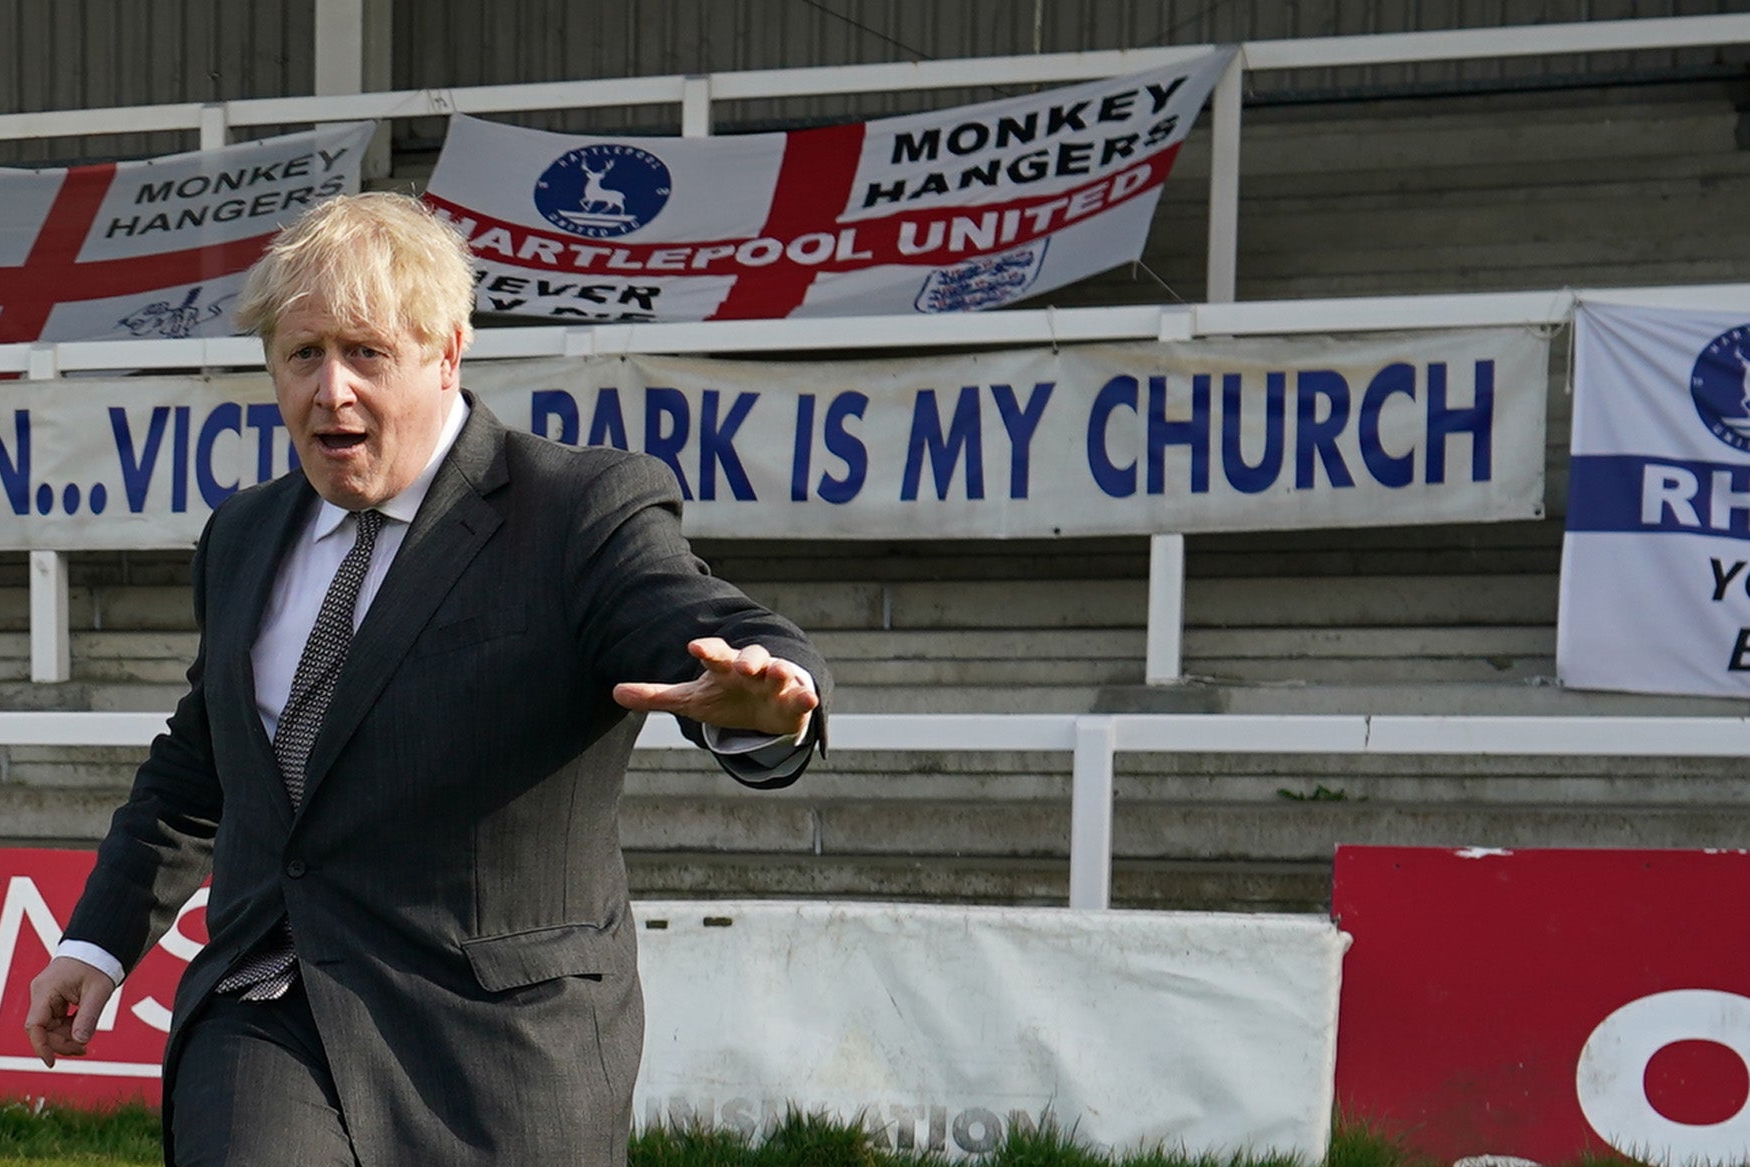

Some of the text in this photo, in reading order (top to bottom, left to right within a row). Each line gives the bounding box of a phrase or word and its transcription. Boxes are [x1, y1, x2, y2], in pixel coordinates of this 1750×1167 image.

[863, 115, 1178, 208] HANGERS
[891, 76, 1188, 164] MONKEY
[105, 175, 345, 238] HANGERS
[135, 149, 349, 204] MONKEY
[434, 163, 1152, 271] HARTLEPOOL UNITED
[791, 391, 869, 504] IS
[900, 381, 1055, 501] MY
[1087, 359, 1495, 498] CHURCH
